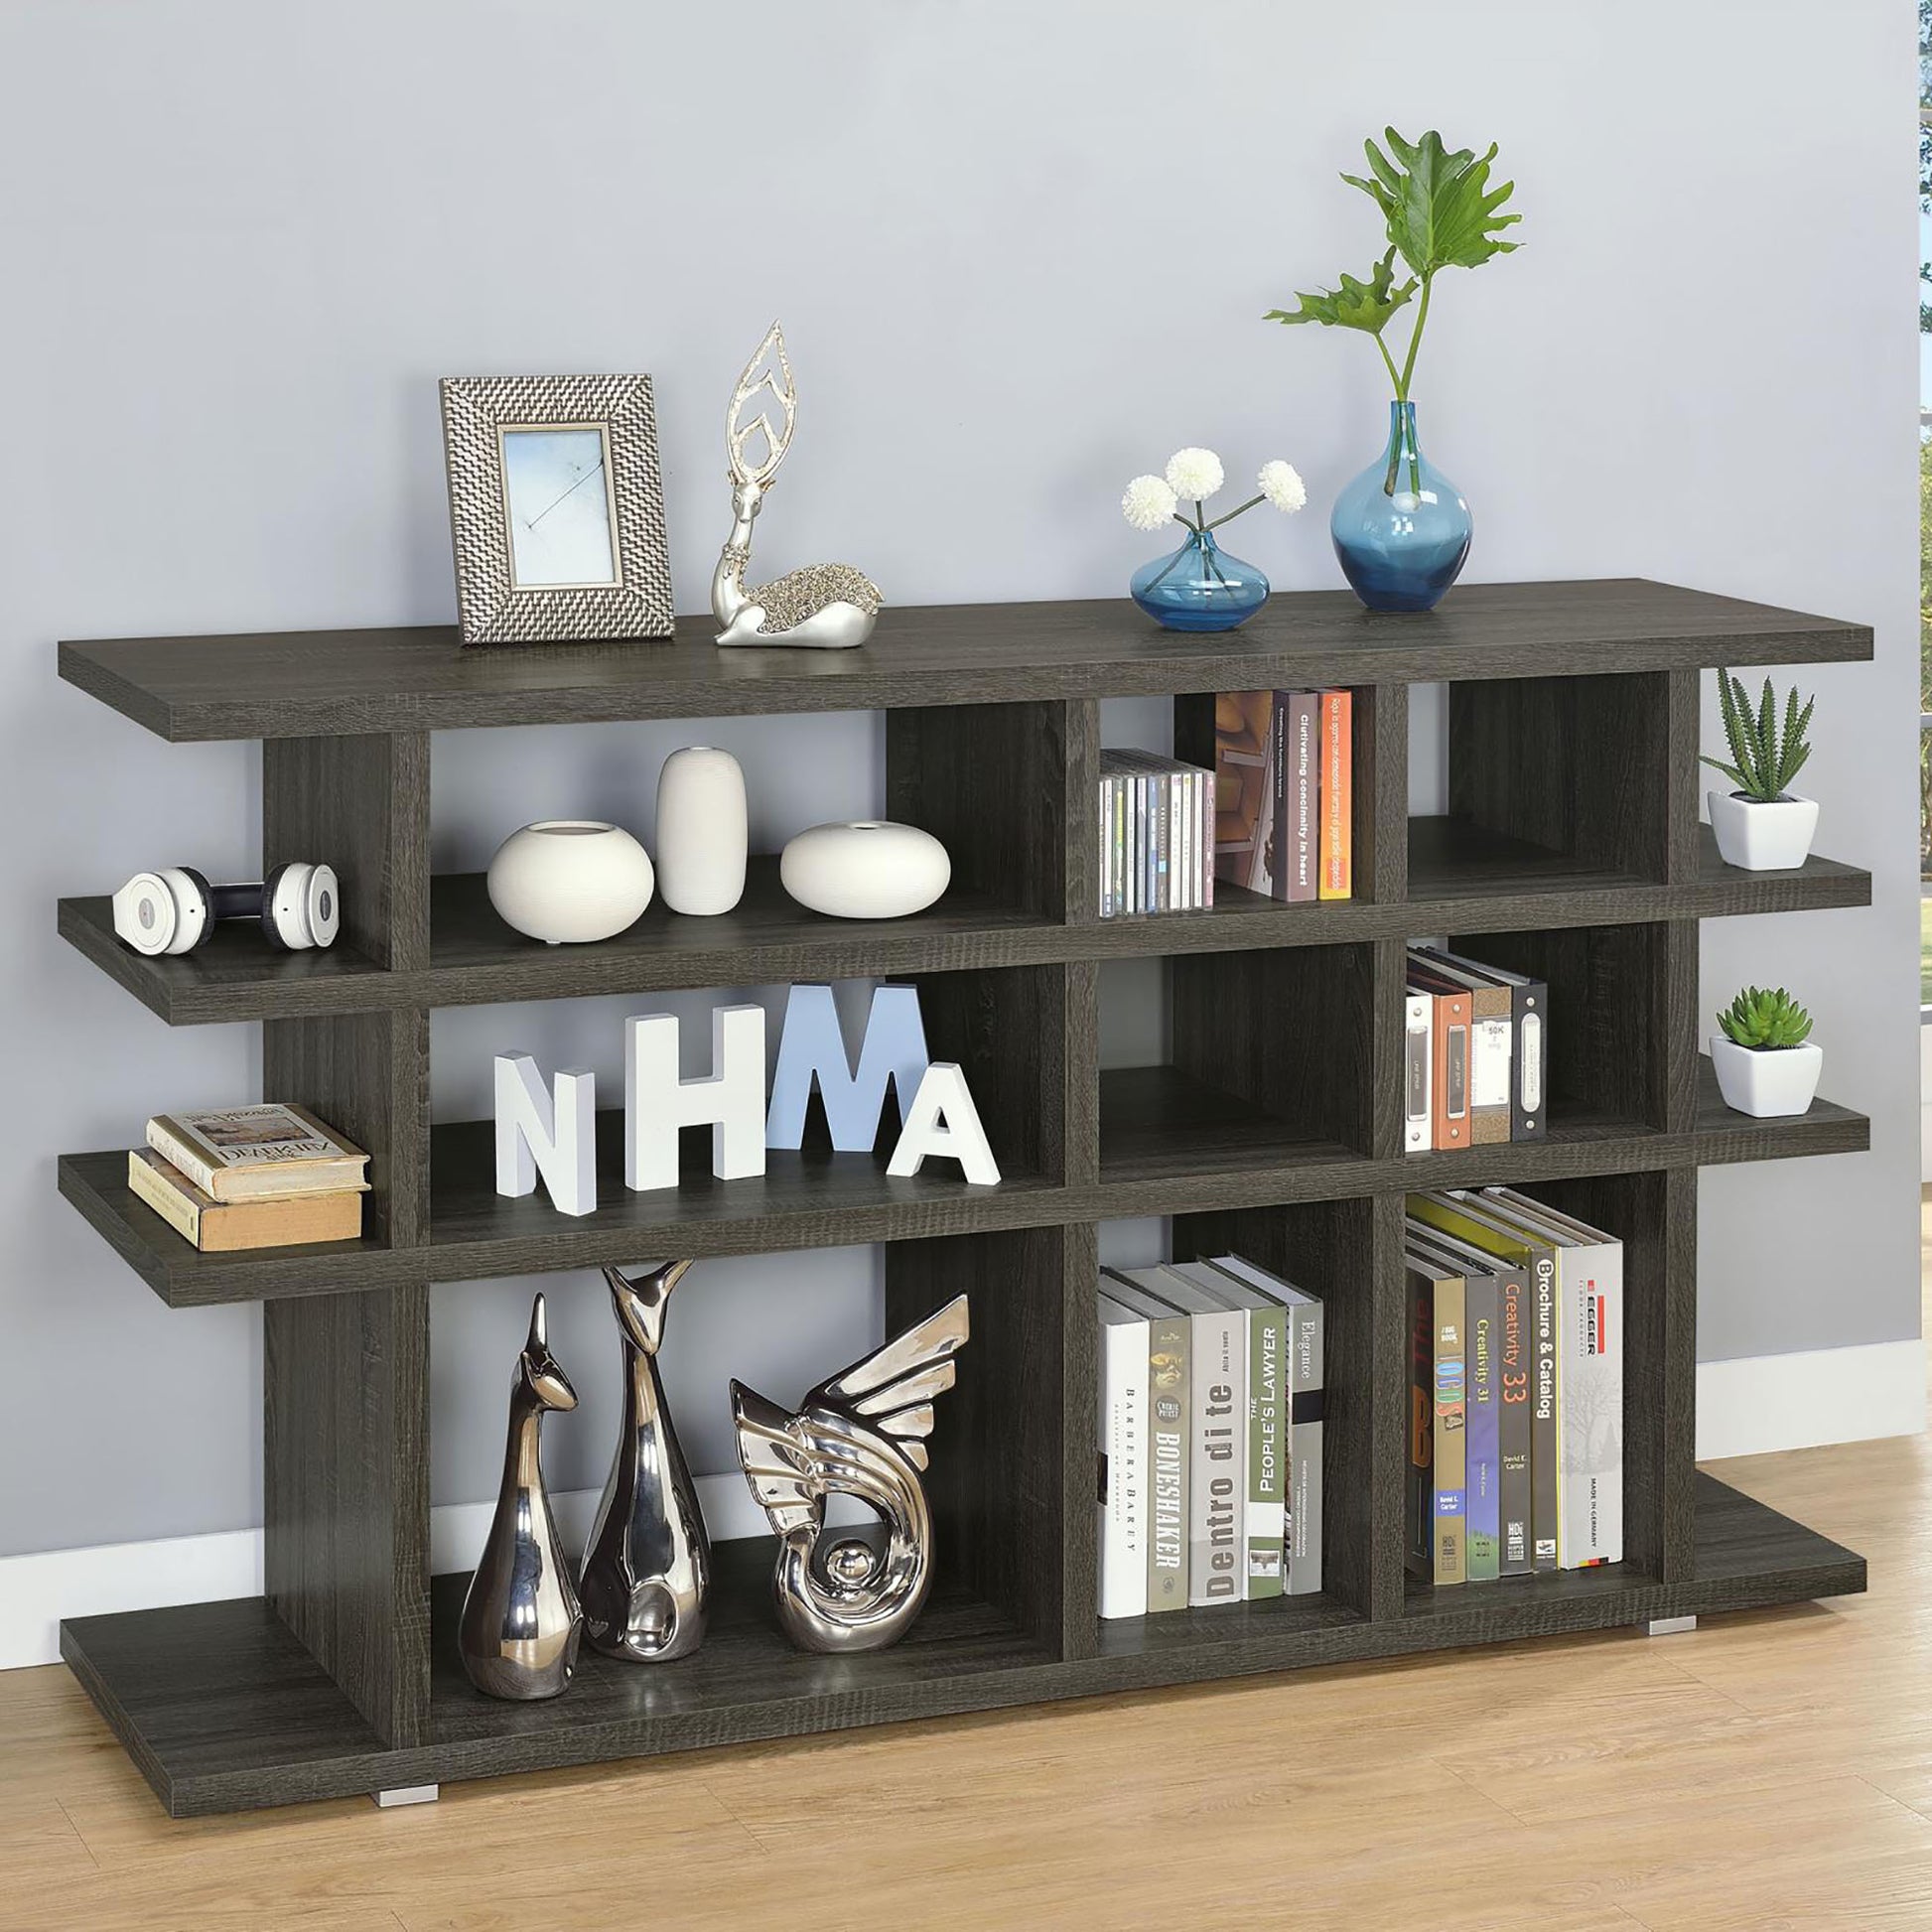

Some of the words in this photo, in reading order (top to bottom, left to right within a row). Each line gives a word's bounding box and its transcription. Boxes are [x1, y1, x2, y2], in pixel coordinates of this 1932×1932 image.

[1300, 841, 1308, 852] in
[1503, 1284, 1520, 1366] Creativity
[1537, 1259, 1554, 1337] Brochure
[1261, 1326, 1276, 1402] LAWYER
[1298, 1320, 1315, 1379] Elegance
[1475, 1319, 1489, 1384] Creativity
[1539, 1342, 1553, 1354] &
[1205, 1385, 1233, 1418] te
[1477, 1388, 1489, 1402] 31
[1503, 1372, 1526, 1403] 33
[1537, 1358, 1553, 1419] Catalog
[1125, 1388, 1135, 1480] BARBERA
[1204, 1428, 1233, 1461] di
[1260, 1408, 1275, 1493] PEOPLE'S
[1156, 1432, 1180, 1568] BONESHAKER
[1206, 1477, 1234, 1597] Dentro
